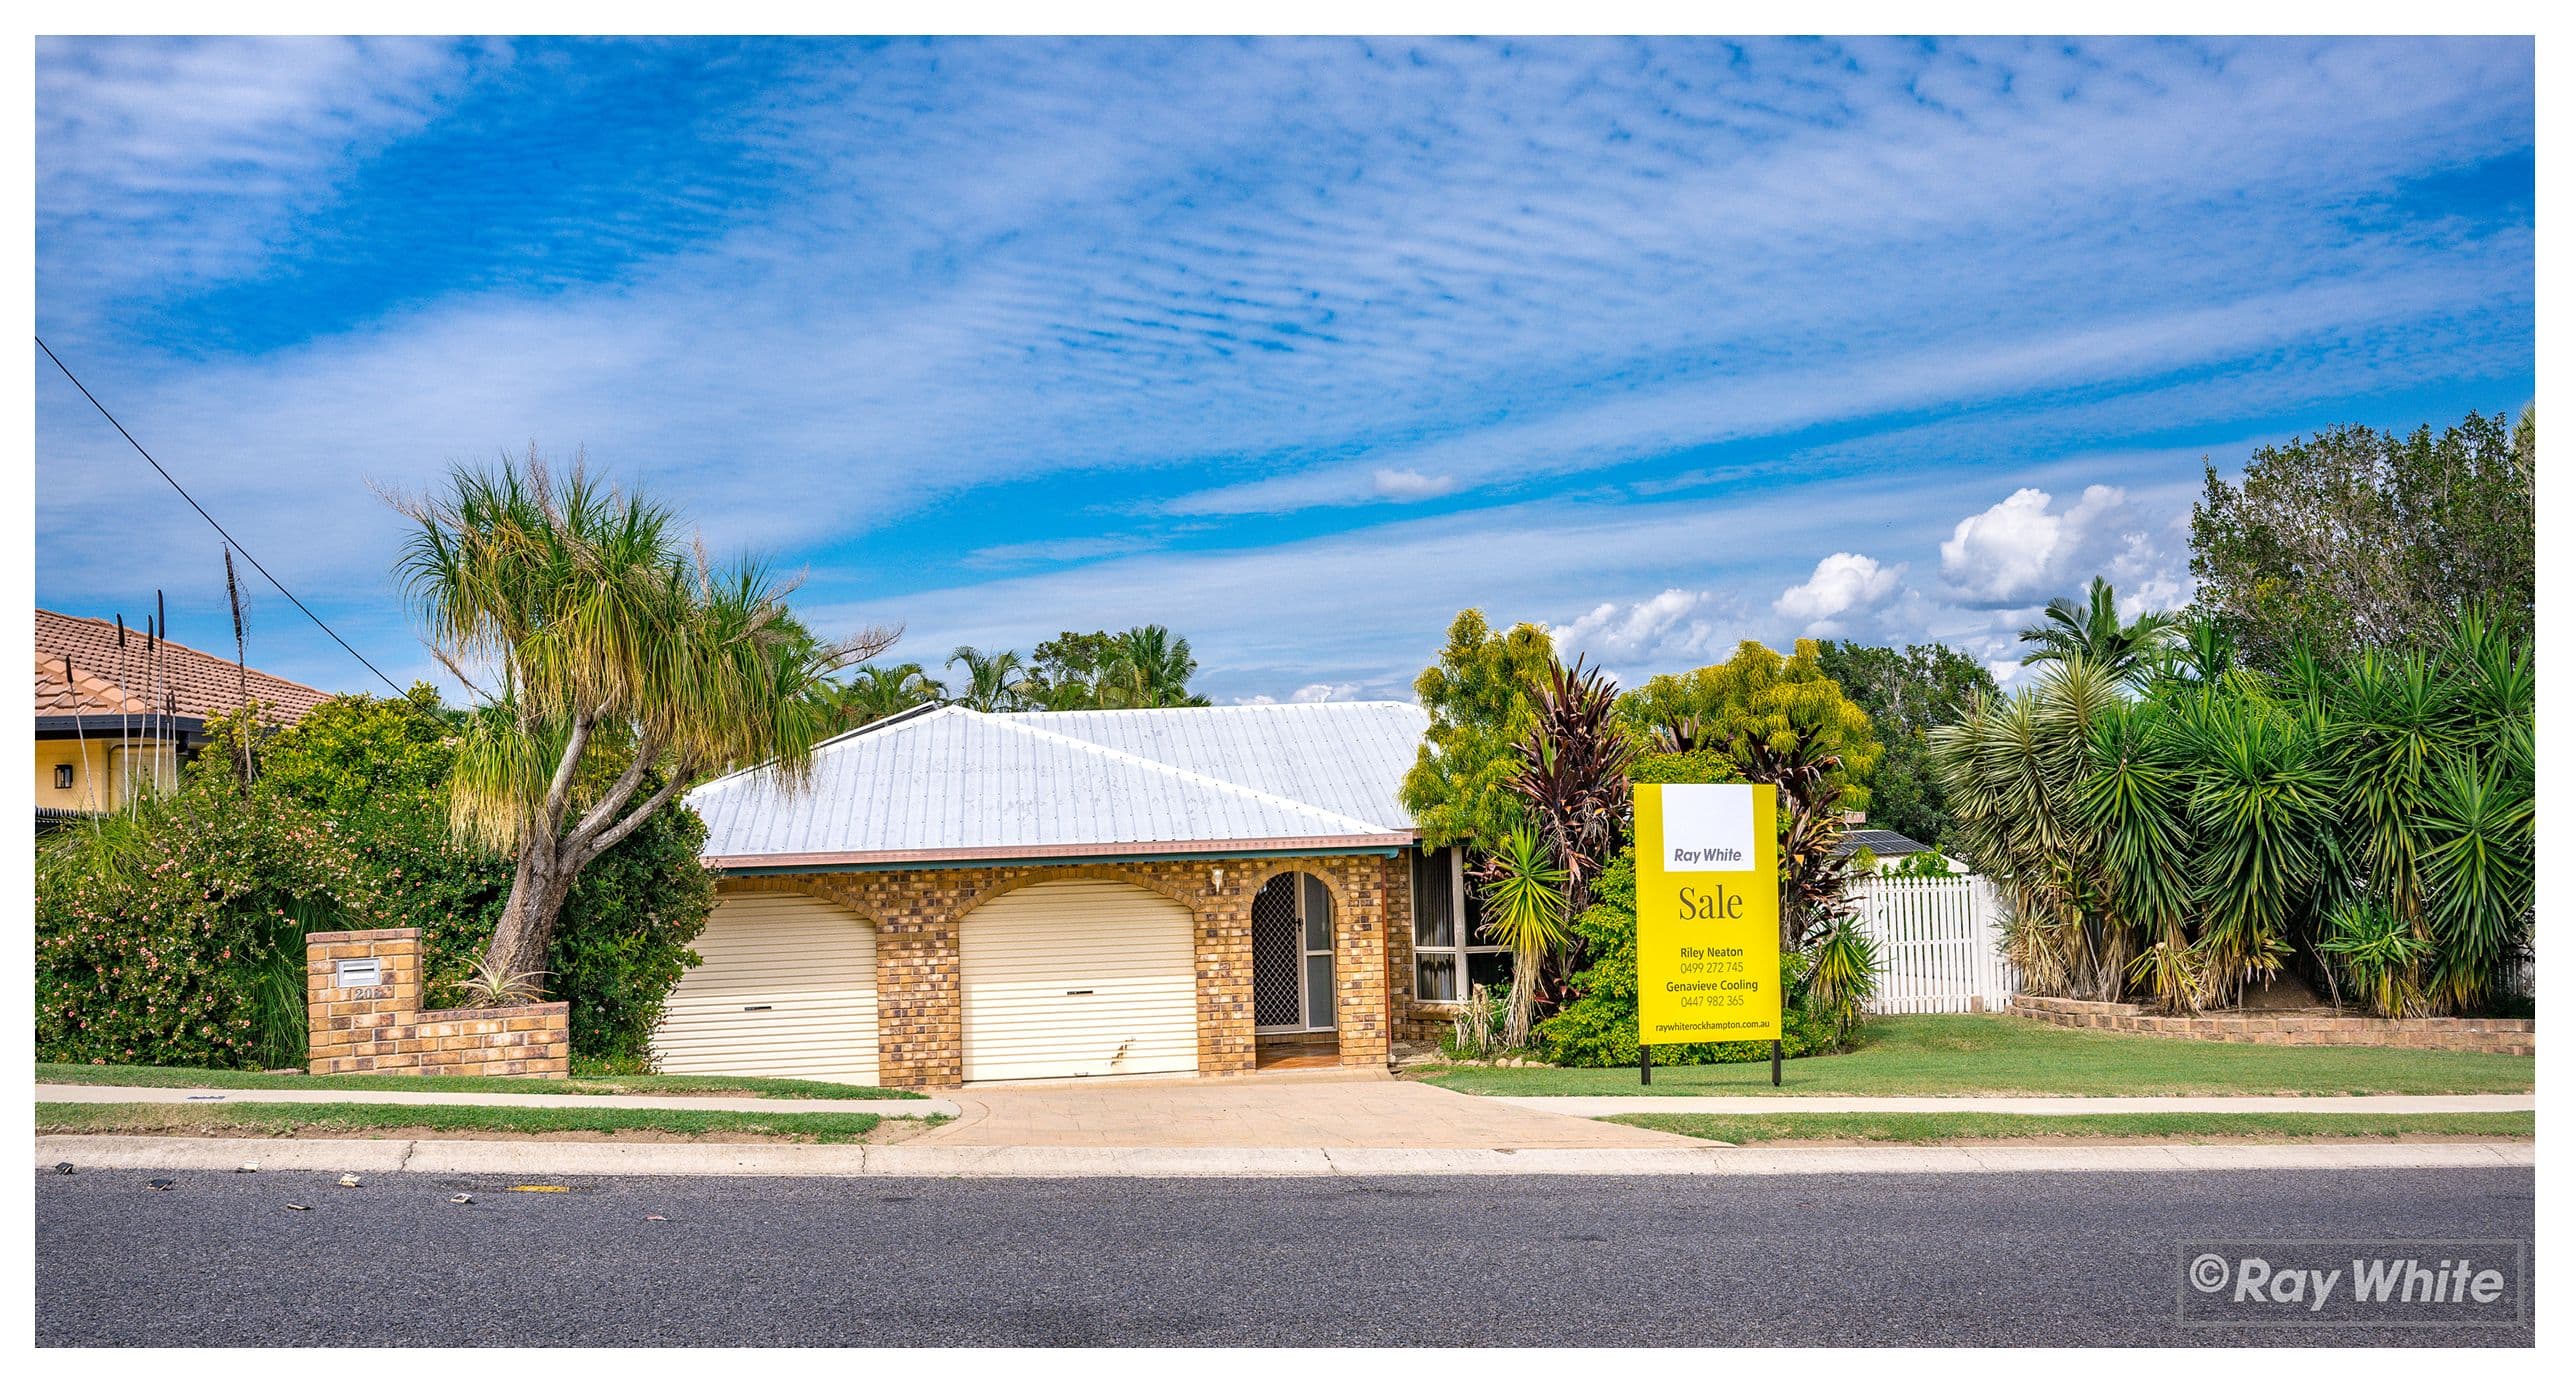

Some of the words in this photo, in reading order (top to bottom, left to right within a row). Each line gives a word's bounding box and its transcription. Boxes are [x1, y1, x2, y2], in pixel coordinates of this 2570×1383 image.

[1674, 848, 1701, 864] Ray
[1704, 848, 1742, 862] White
[1679, 884, 1743, 921] Sale
[1680, 947, 1704, 960] Riley
[1707, 947, 1744, 957] Neaton
[1680, 963, 1704, 974] 0499
[1706, 962, 1724, 973] 272
[1727, 962, 1744, 972] 745
[1666, 981, 1718, 992] Genavieve
[1720, 979, 1758, 992] Cooling
[1681, 996, 1704, 1007] 0447
[1707, 995, 1725, 1006] 982
[1727, 995, 1744, 1006] 365
[1655, 1020, 1770, 1033] raywhiterockhampton.com.au
